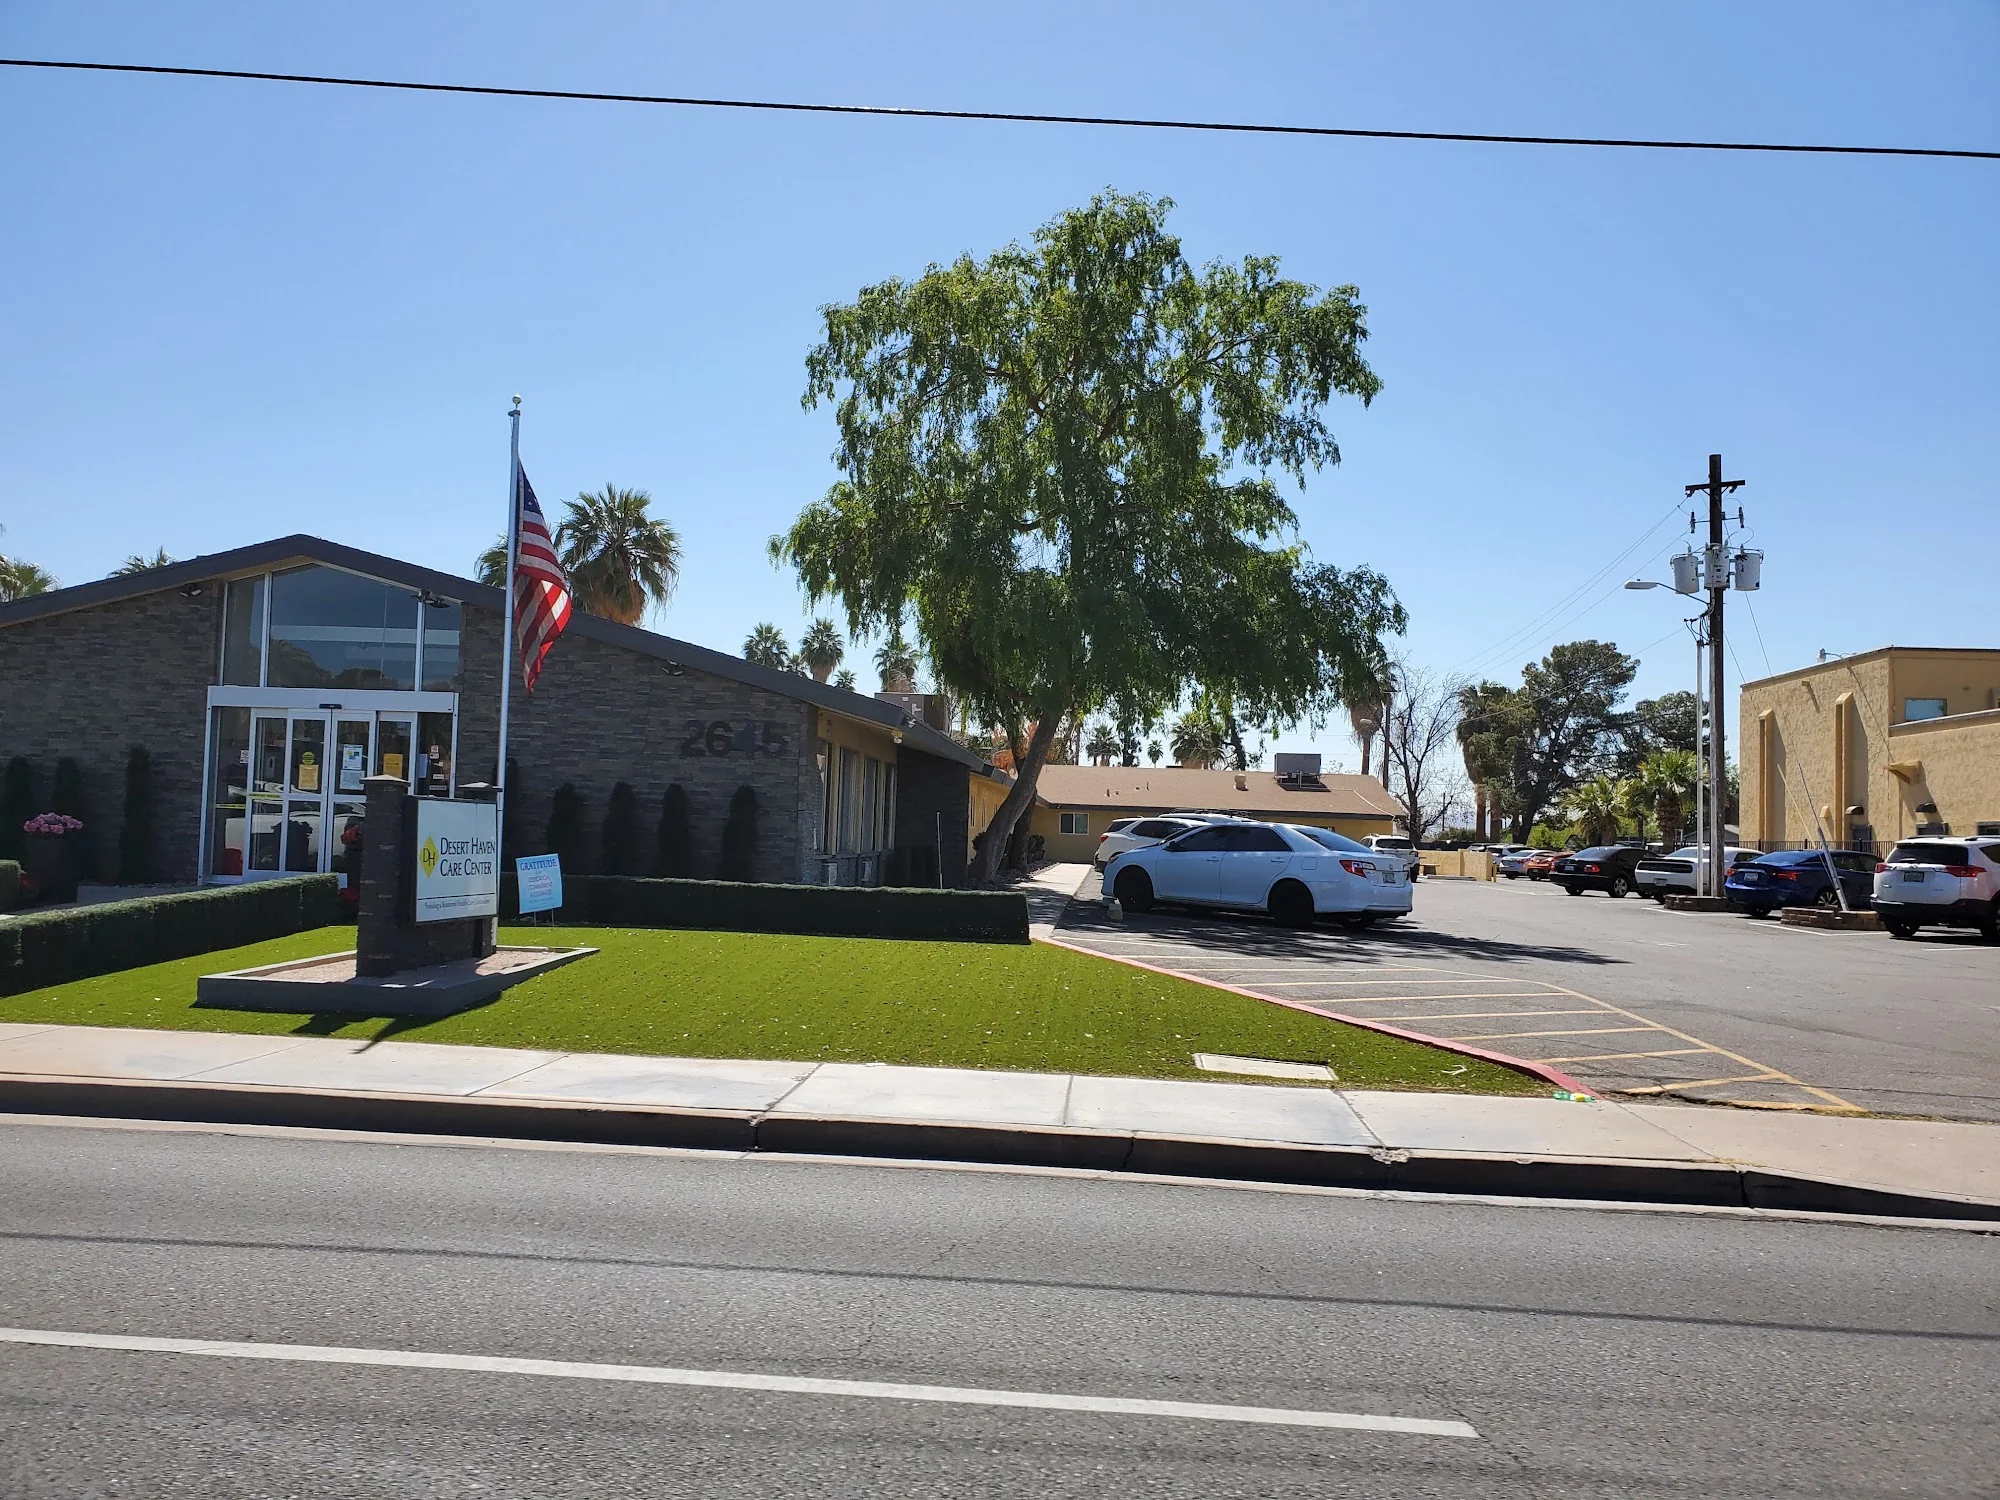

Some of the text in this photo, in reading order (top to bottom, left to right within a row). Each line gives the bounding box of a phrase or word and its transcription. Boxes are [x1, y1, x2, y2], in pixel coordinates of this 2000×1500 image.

[681, 719, 790, 757] 2645
[441, 837, 496, 855] DESERT HAVEN
[422, 847, 435, 866] DH
[520, 859, 557, 871] GRATITUDE
[440, 858, 492, 877] CARE CENTER
